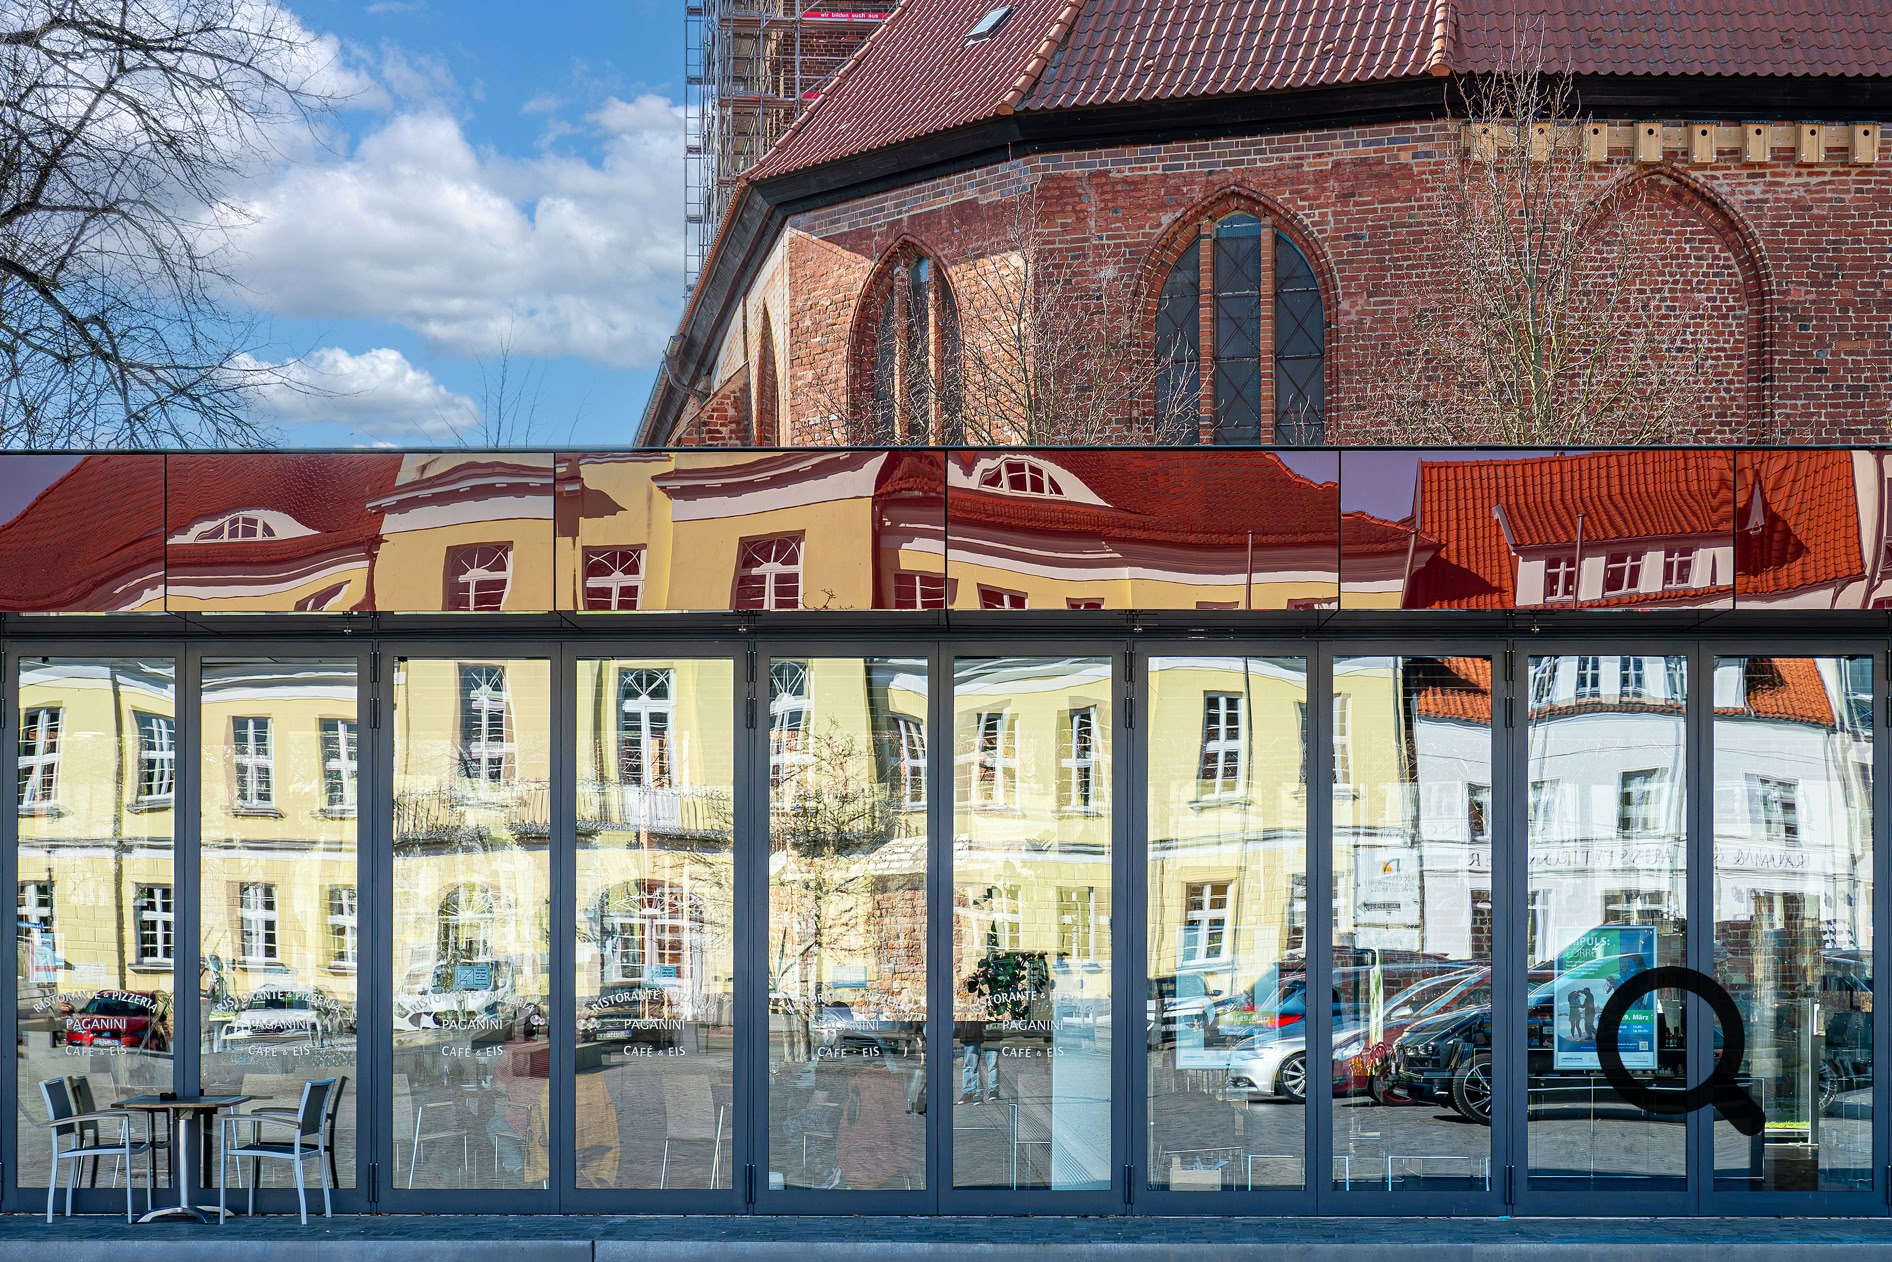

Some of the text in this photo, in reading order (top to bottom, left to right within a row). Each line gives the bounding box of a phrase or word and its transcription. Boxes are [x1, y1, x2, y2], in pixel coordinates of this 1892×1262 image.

[1566, 936, 1610, 946] MPULS:
[32, 990, 101, 1013] RISTORANTE
[112, 991, 158, 1014] PIZZERIA
[216, 990, 284, 1012] RISTORANTE
[295, 991, 342, 1013] PIZZERIA
[410, 991, 477, 1013] RISTORANTE
[488, 991, 535, 1014] PIZRIA
[591, 990, 659, 1013] RISTORANTE
[66, 1018, 127, 1030] PAGANINI
[250, 1018, 311, 1030] PAGANINI
[442, 1019, 503, 1030] PAGANINI
[624, 1019, 685, 1030] PAGANINI
[1002, 1019, 1063, 1031] PAGANINI
[65, 1045, 94, 1057] CAFÉ
[109, 1045, 127, 1056] EIS
[293, 1045, 310, 1056] EIS
[441, 1045, 470, 1058] CAFÉ
[486, 1045, 503, 1057] EIS
[623, 1045, 652, 1057] CAFÉ
[668, 1045, 686, 1057] EIS
[862, 1046, 880, 1058] EIS
[1001, 1046, 1031, 1058] CAFÉ
[1047, 1046, 1064, 1058] EIS
